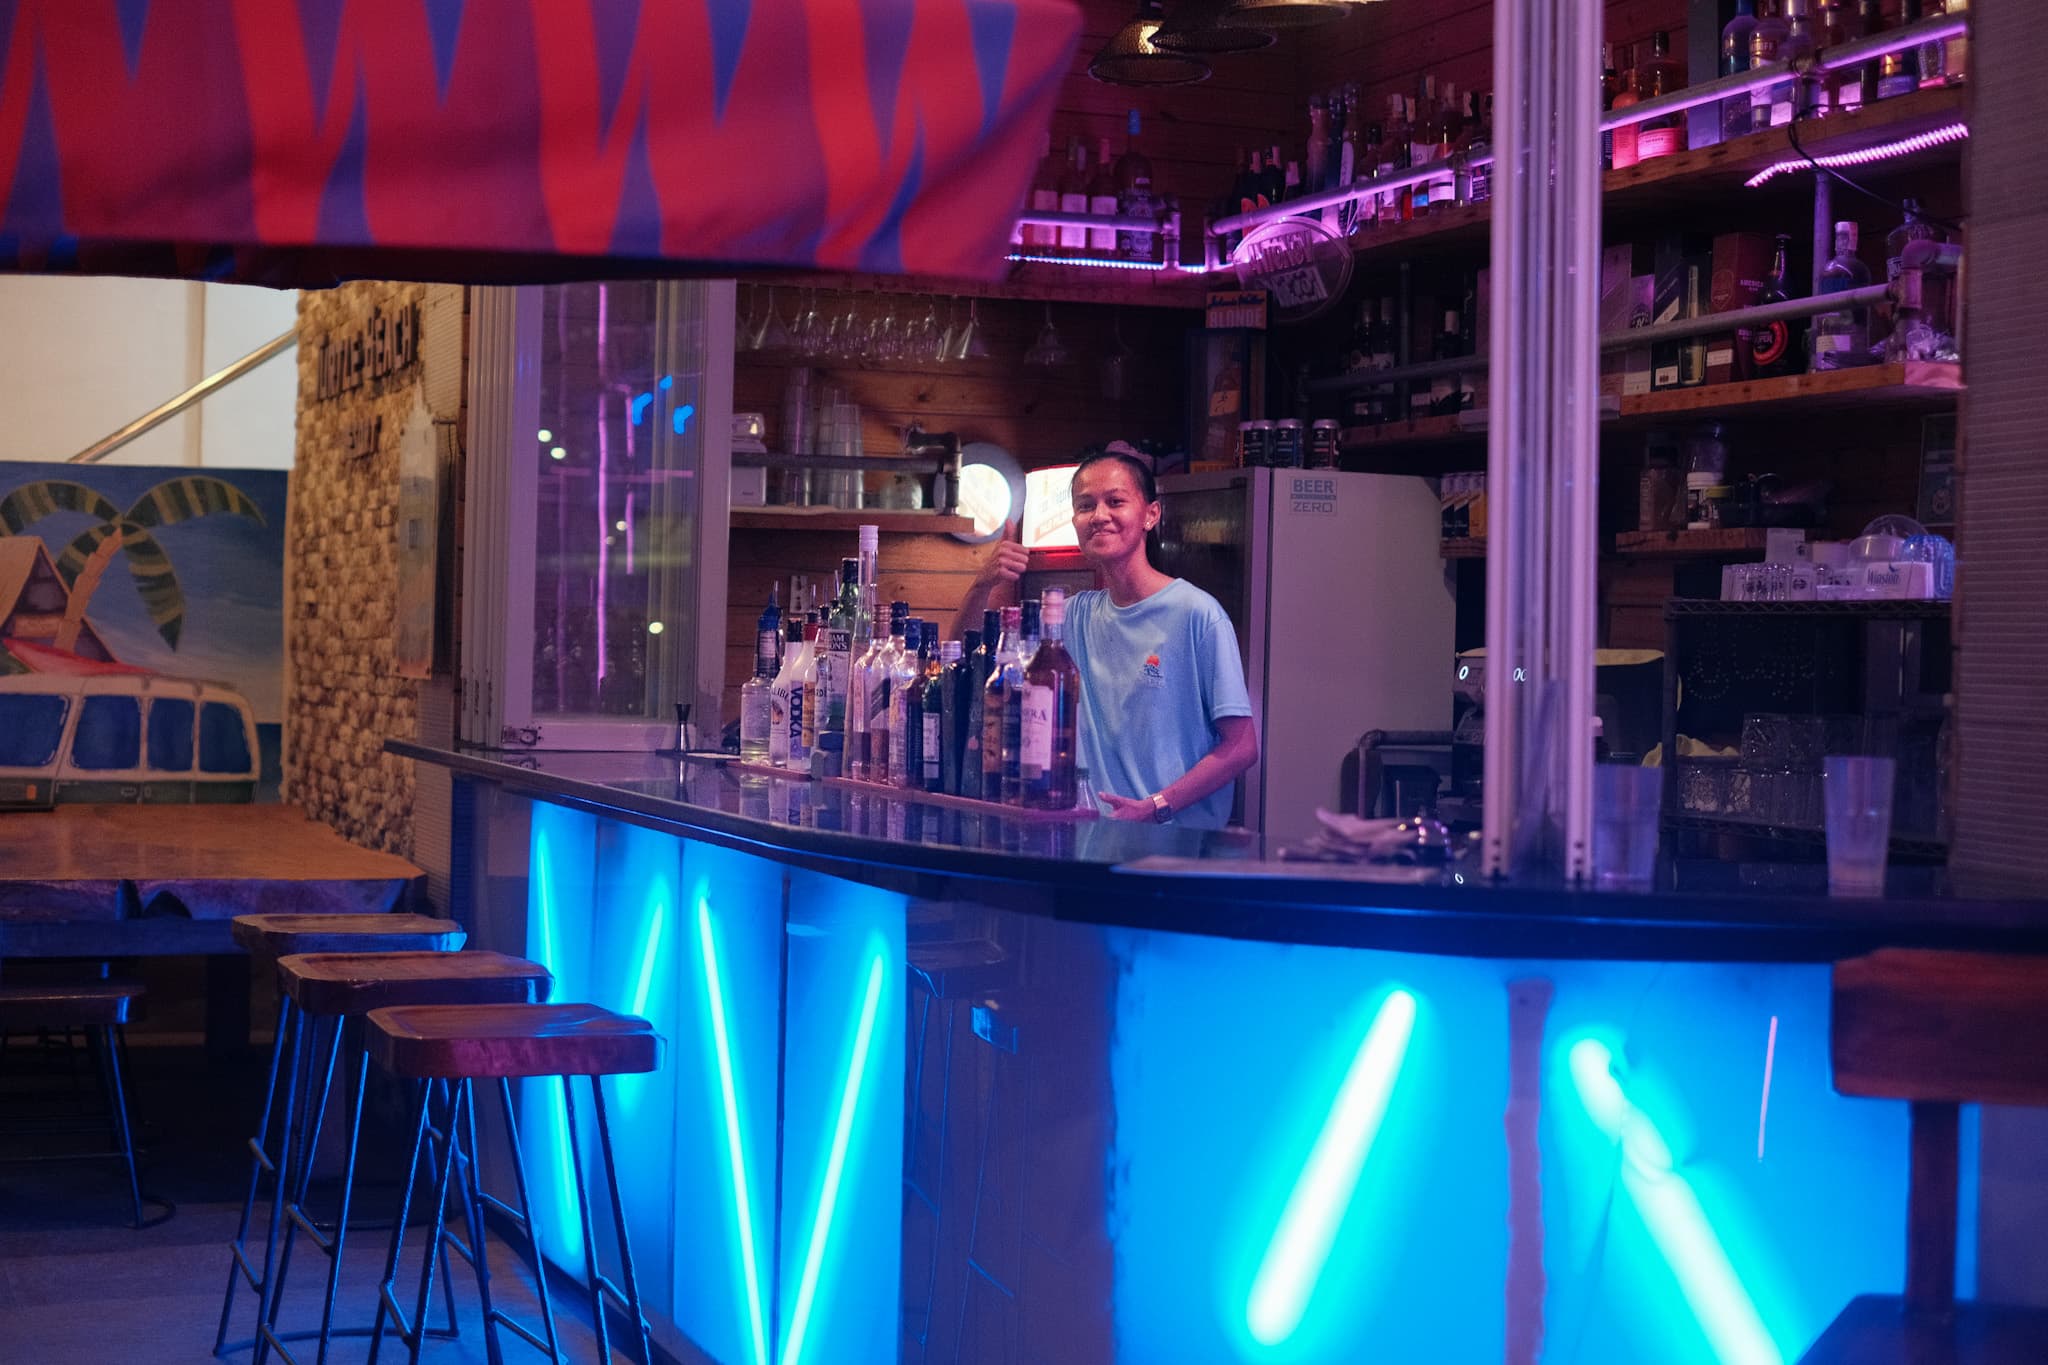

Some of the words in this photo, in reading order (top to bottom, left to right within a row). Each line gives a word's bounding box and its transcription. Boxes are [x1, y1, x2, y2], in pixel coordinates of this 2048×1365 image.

[1210, 309, 1264, 329] BLONDE
[363, 303, 420, 378] BEACH
[1293, 479, 1334, 493] BEER
[1293, 501, 1333, 513] ZERO
[790, 686, 803, 738] VODKA
